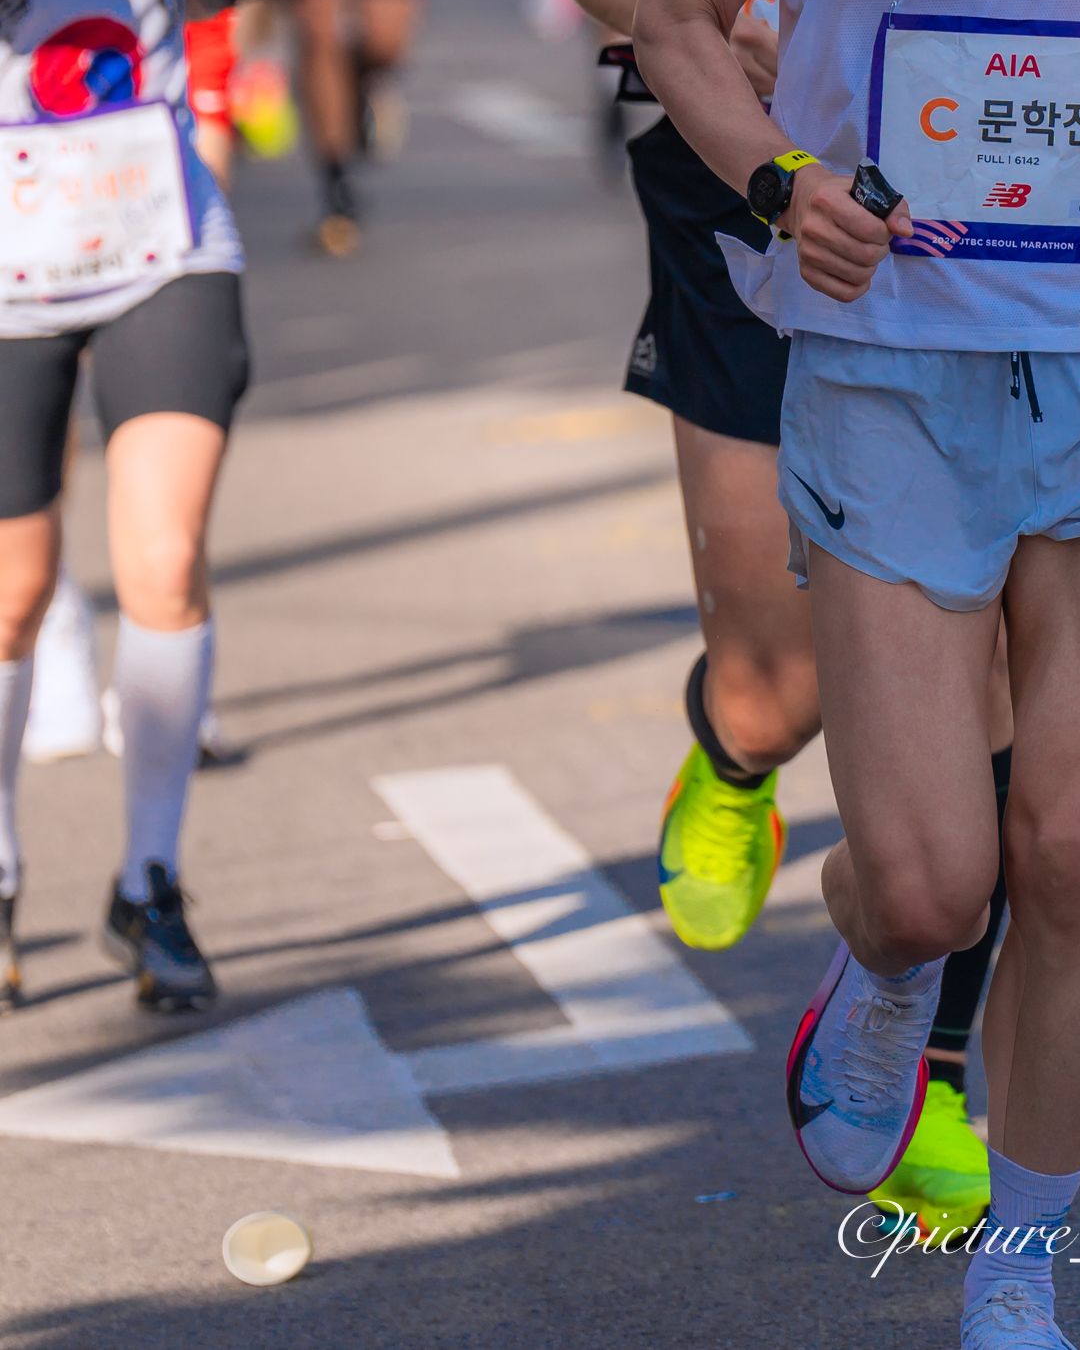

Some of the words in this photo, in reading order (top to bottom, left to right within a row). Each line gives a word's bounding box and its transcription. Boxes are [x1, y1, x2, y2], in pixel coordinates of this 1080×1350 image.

[984, 53, 1041, 78] AIA
[920, 97, 960, 142] C
[976, 154, 1005, 164] FULL
[1014, 155, 1040, 166] 6142
[932, 236, 956, 245] 2024
[959, 238, 984, 247] JTBC
[985, 239, 1018, 248] SEOUL
[1020, 240, 1075, 250] MARATHON
